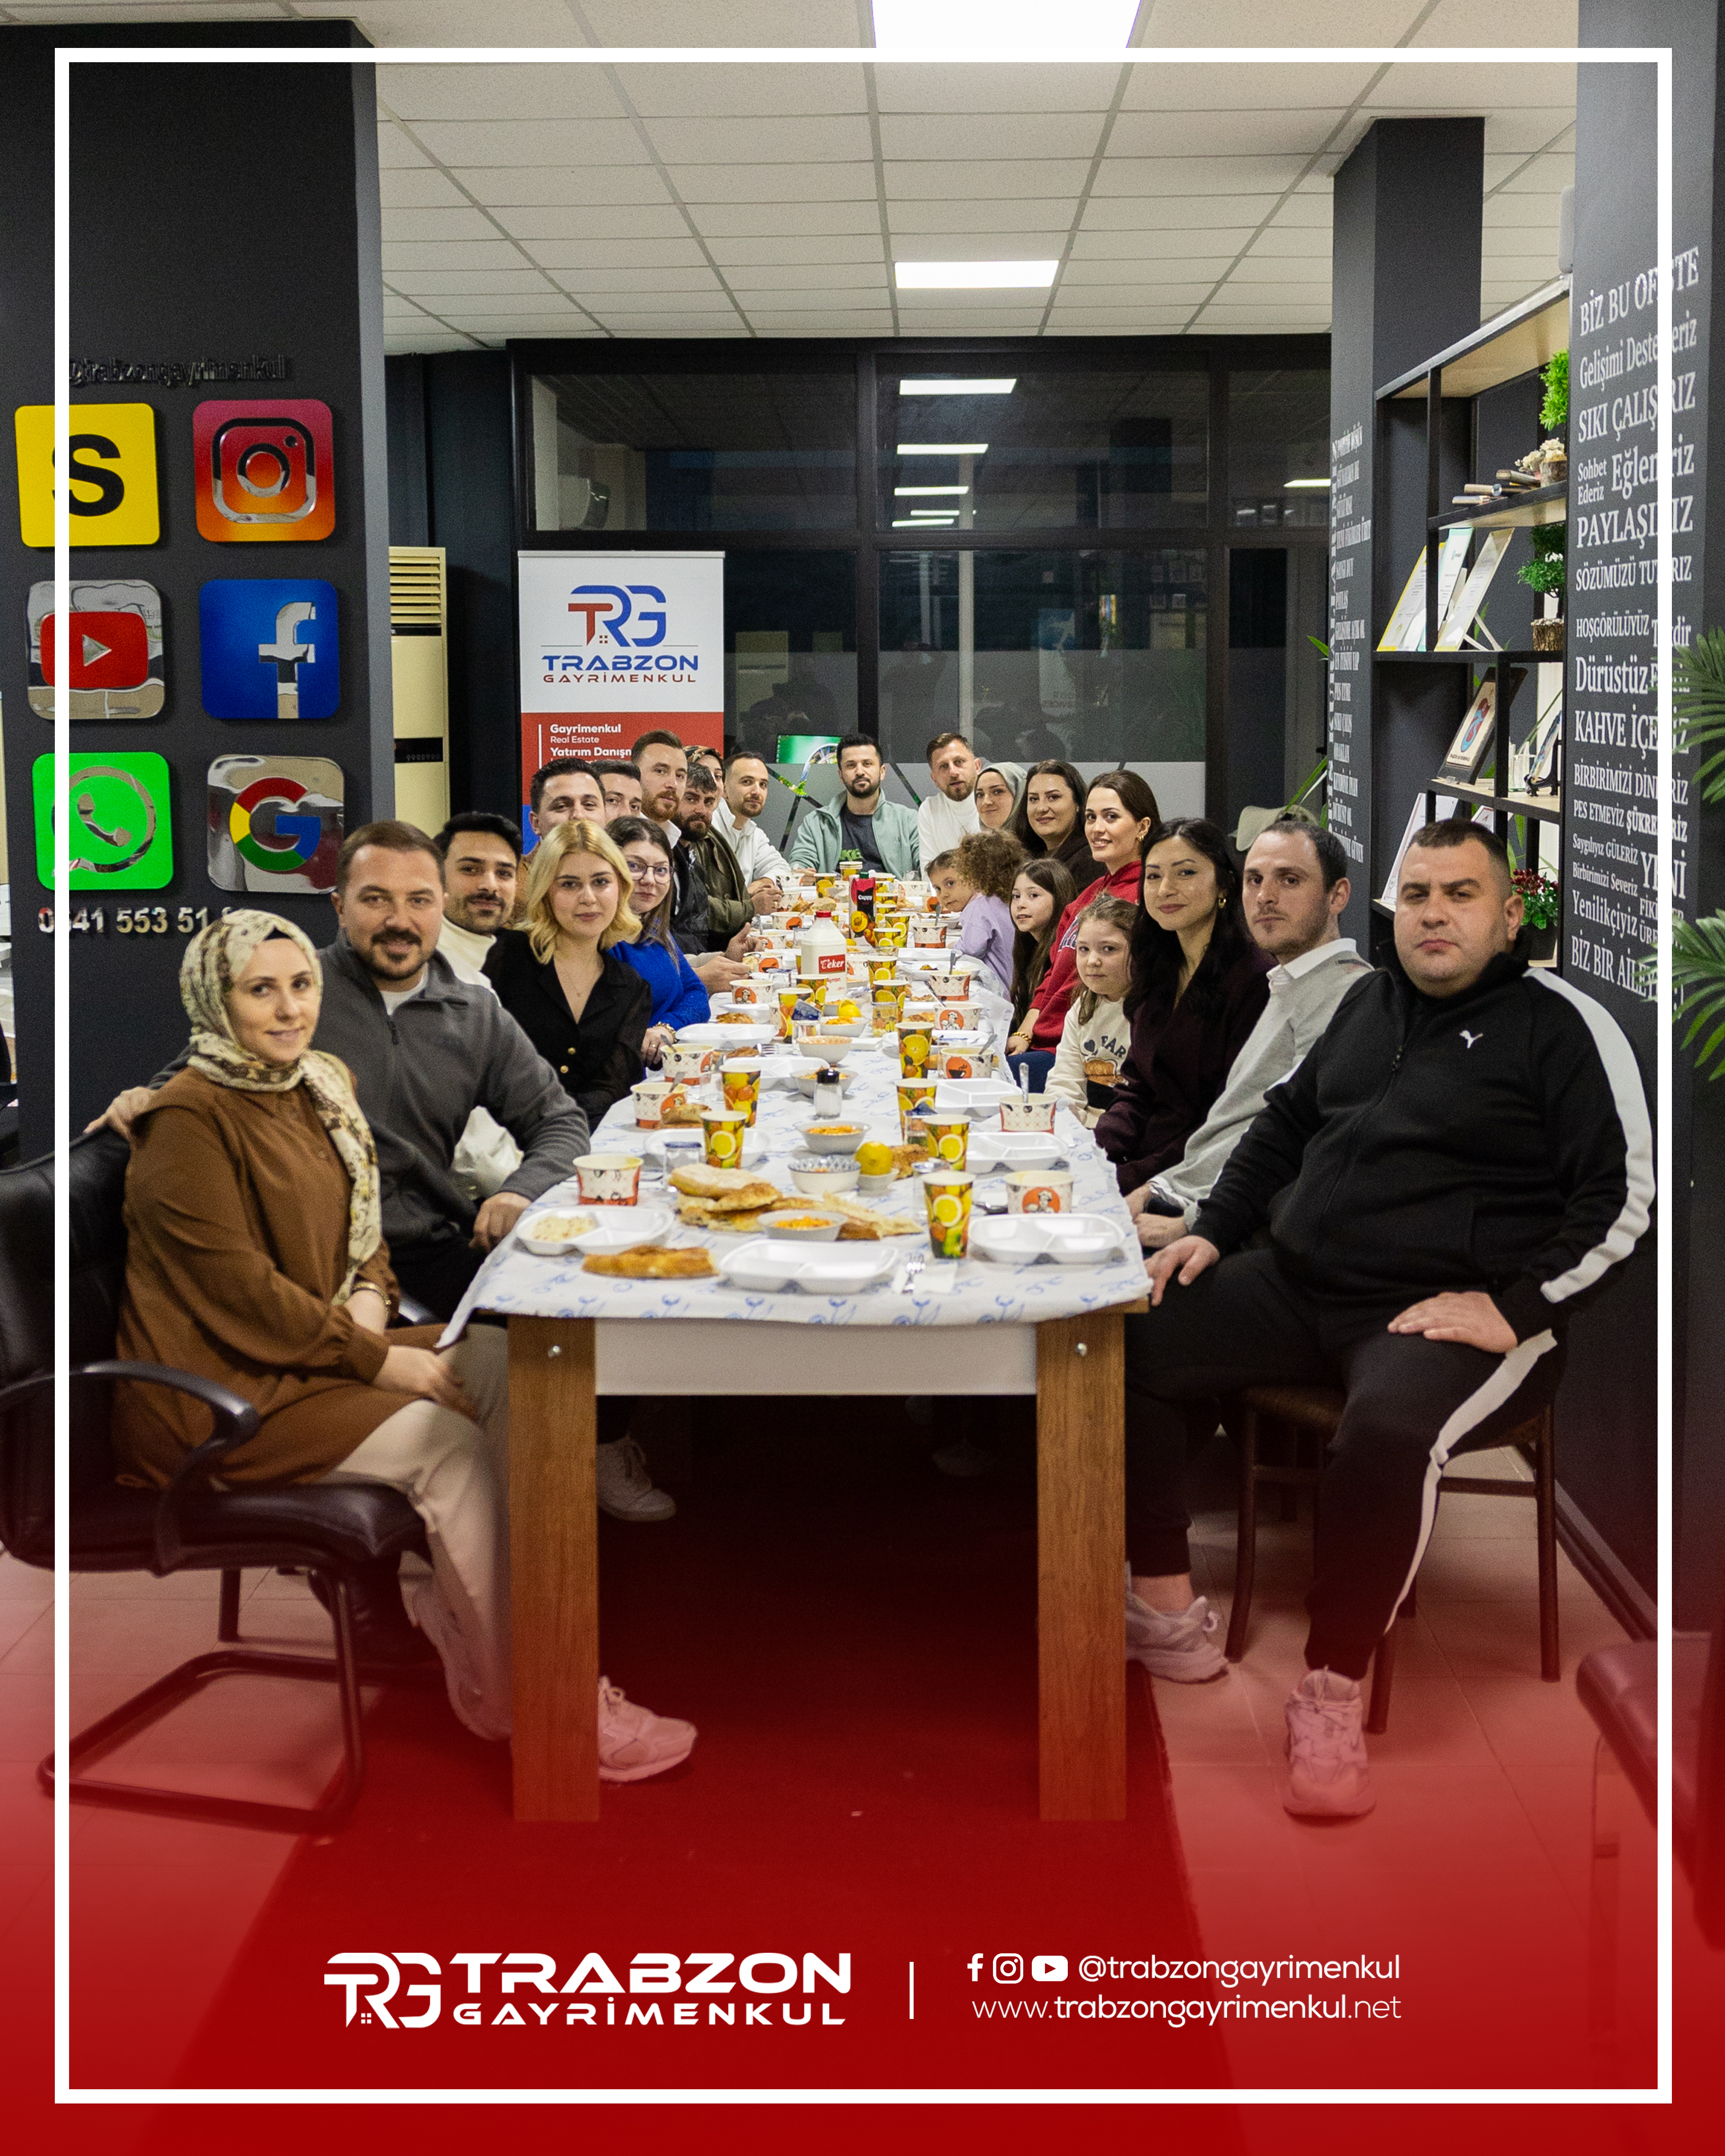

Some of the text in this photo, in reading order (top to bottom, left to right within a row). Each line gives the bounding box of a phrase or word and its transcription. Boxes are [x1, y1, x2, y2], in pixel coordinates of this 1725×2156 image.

[1580, 289, 1604, 336] BİZ
[1608, 281, 1630, 324] BU
[1580, 339, 1623, 392] Gelişimi
[1578, 403, 1608, 443] SIKI
[1578, 457, 1607, 482] Sohbet
[1578, 481, 1605, 505] Ederiz
[1575, 556, 1636, 591] SÖZÜMÜZÜ
[1575, 609, 1650, 643] HOŞGÖRÜLÜYÜZ
[541, 655, 698, 671] TRABZON
[543, 672, 697, 683] GAYRİMENKUL
[1575, 655, 1648, 695] Dürüstüz
[550, 723, 621, 735] Gayrimenkul
[1575, 710, 1626, 747] KAHVE
[550, 747, 591, 757] Yatırım
[1574, 758, 1632, 795] BİRBİRİMİZİ
[1573, 799, 1587, 819] PES
[1589, 802, 1625, 828] ETMEYİZ
[1573, 833, 1638, 865] Saygılıyız GÜLERİZ
[1573, 861, 1638, 897] Birbirimizi Severiz
[38, 907, 208, 933] 041 553 51
[1572, 889, 1638, 939] Yenilikçiyiz
[1571, 929, 1591, 972] BİZ
[1593, 938, 1614, 983] BİR
